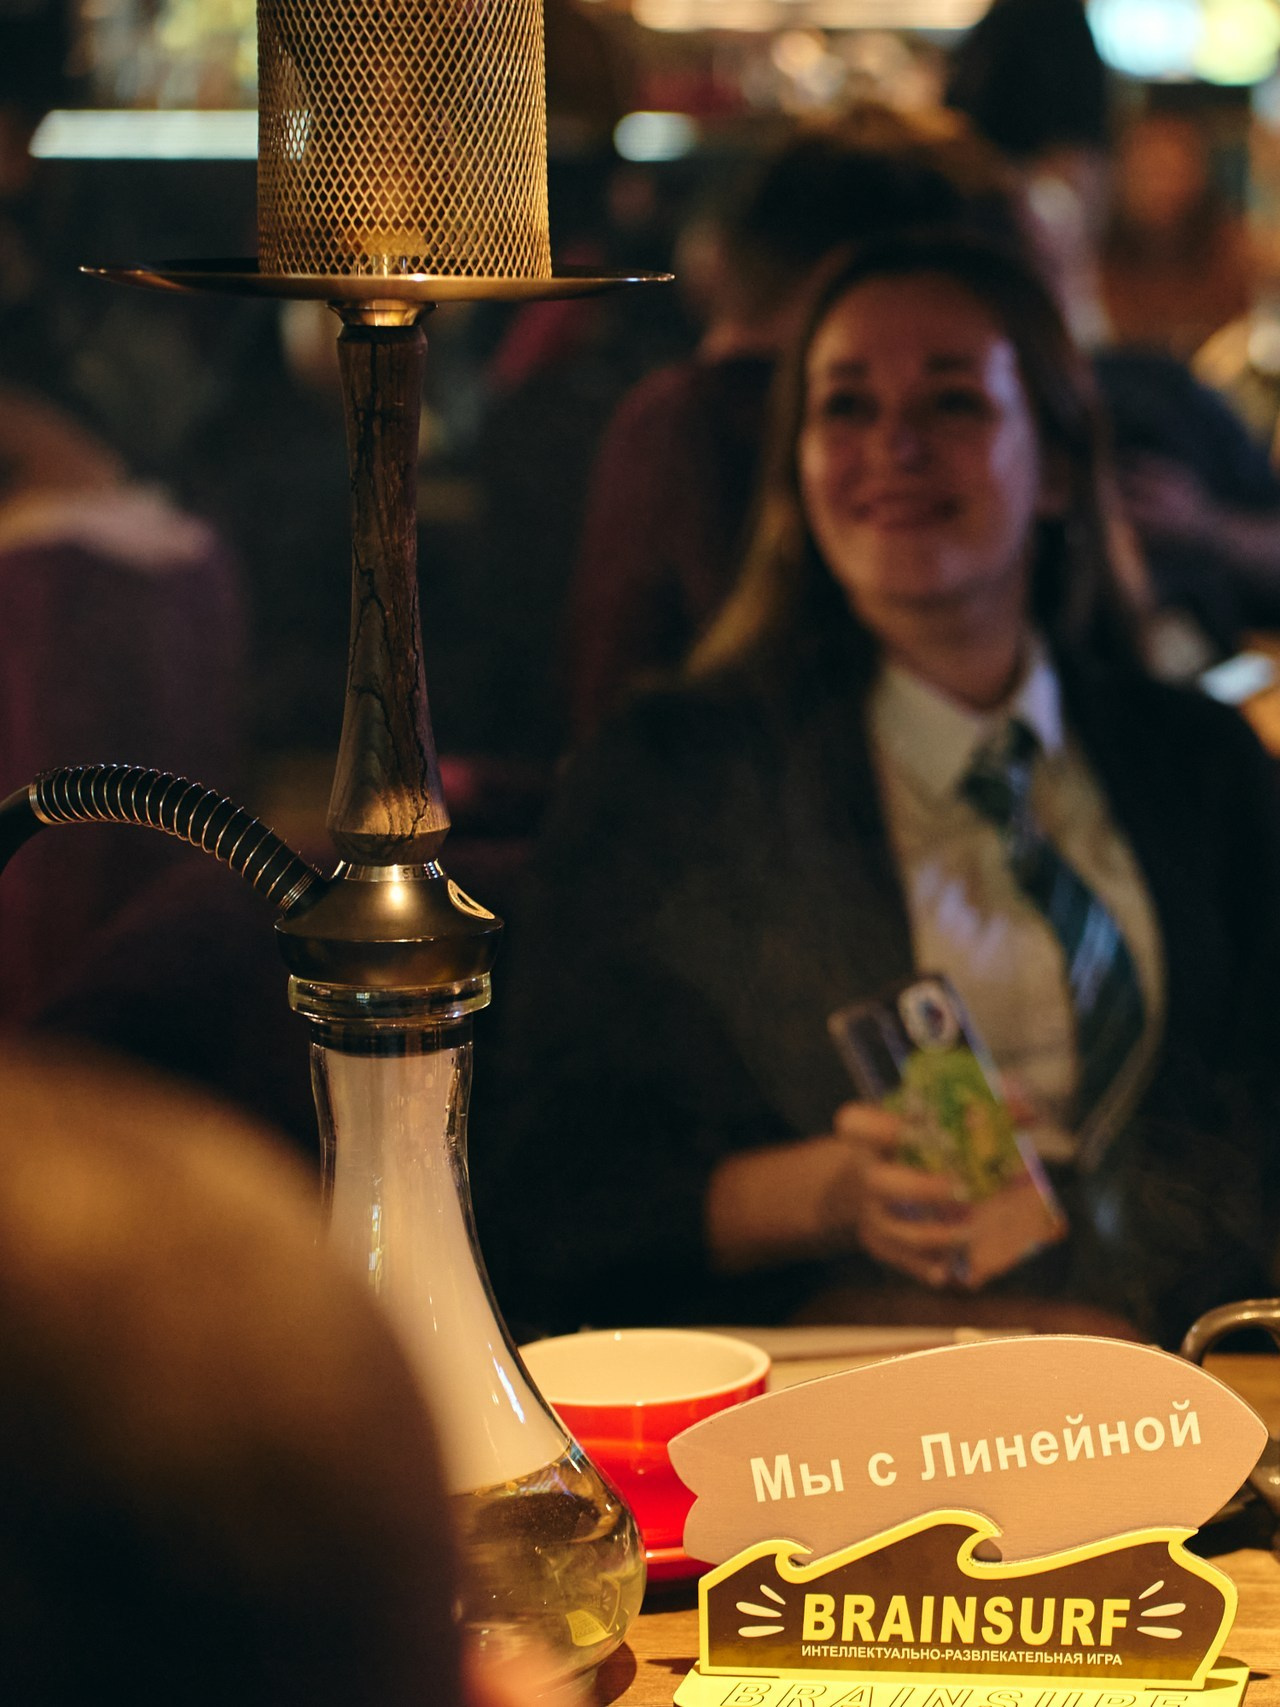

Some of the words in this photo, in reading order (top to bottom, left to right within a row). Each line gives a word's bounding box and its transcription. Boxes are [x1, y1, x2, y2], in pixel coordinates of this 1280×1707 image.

[750, 1452, 844, 1503] Мы
[867, 1451, 898, 1487] с
[920, 1399, 1203, 1481] Линейной
[801, 1592, 1132, 1647] BRAINSURF
[800, 1643, 1083, 1665] ИНТЕЛЛЕКТУАЛЬНО-РАЗВЛЕКАТЕЛЬНАЯ
[1086, 1651, 1123, 1666] ИГРА
